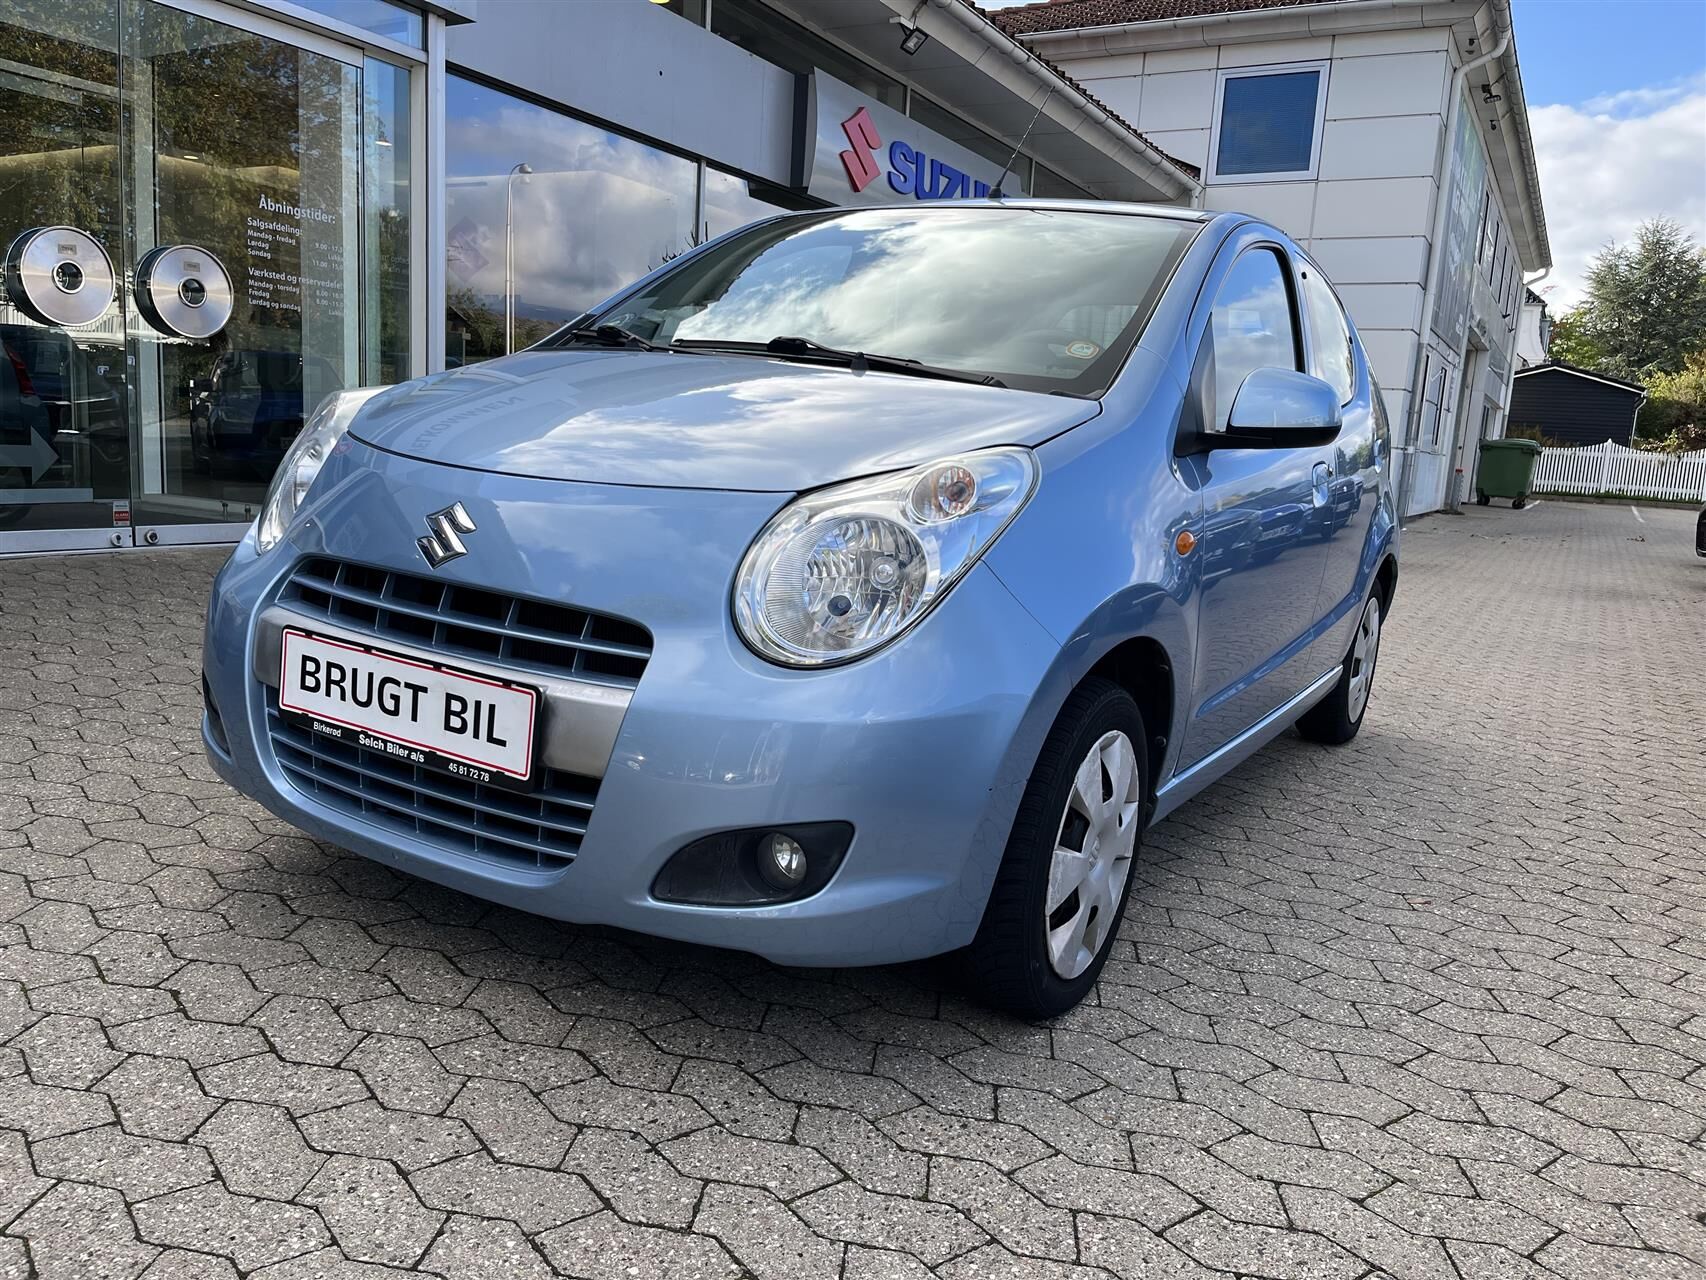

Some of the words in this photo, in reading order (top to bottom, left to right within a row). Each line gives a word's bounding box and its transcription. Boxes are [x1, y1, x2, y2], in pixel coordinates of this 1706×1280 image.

[259, 194, 336, 224] Åbningstider:
[247, 217, 303, 236] Salgsafdeling:
[247, 229, 273, 241] Mandag
[276, 234, 296, 245] fredag
[248, 267, 286, 281] Værksted
[287, 275, 297, 284] og
[248, 279, 274, 290] Mandag
[277, 284, 300, 294] torsdag
[248, 288, 270, 298] Fredag
[300, 654, 429, 723] BRUGT
[443, 691, 508, 748] BIL
[359, 733, 385, 751] Selch
[386, 742, 409, 758] Biler
[410, 751, 425, 762] a/s
[448, 762, 458, 773] 45
[458, 765, 468, 776] 81
[469, 768, 479, 779] 72
[480, 771, 490, 782] 78
